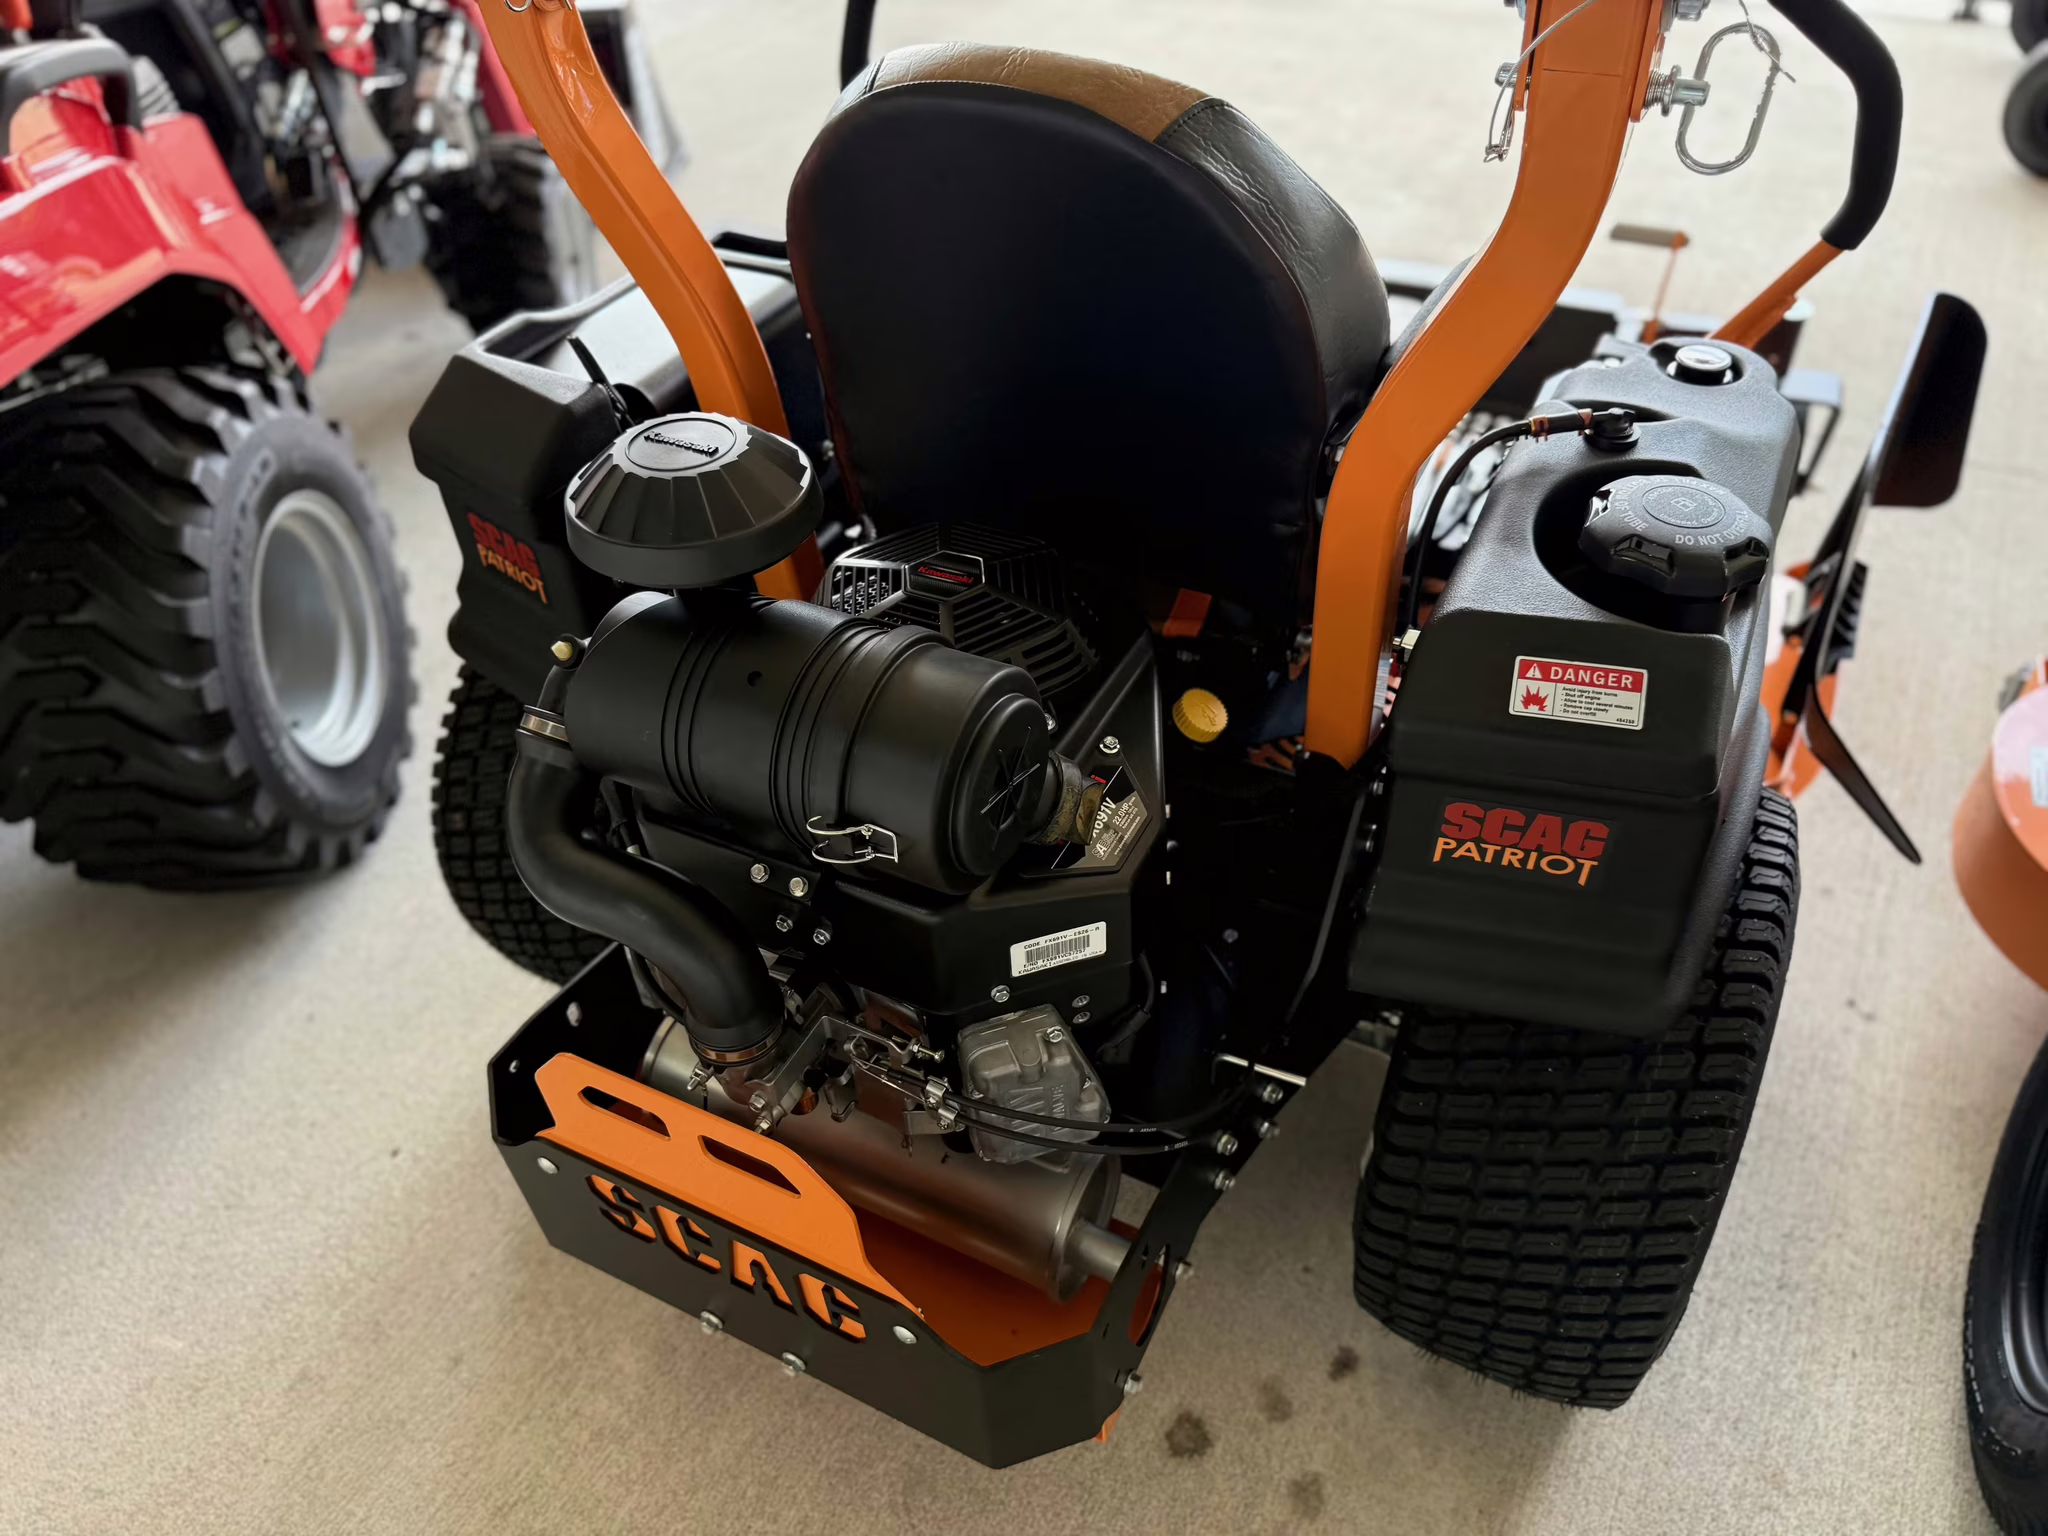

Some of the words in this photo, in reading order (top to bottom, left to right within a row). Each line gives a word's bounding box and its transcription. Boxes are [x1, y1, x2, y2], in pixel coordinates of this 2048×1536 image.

[1620, 510, 1649, 532] TUBE
[467, 512, 542, 580] SCAG
[1674, 534, 1694, 545] DO
[1697, 533, 1724, 545] NOT
[477, 543, 548, 604] PATRIOT
[1550, 666, 1633, 689] DANGER
[1577, 688, 1591, 696] injury
[1441, 802, 1610, 859] SCAG
[1432, 837, 1599, 887] PATRIOT
[1023, 941, 1041, 950] CODE
[1018, 961, 1052, 975] KAWASAKI
[585, 1174, 867, 1342] SCAG
